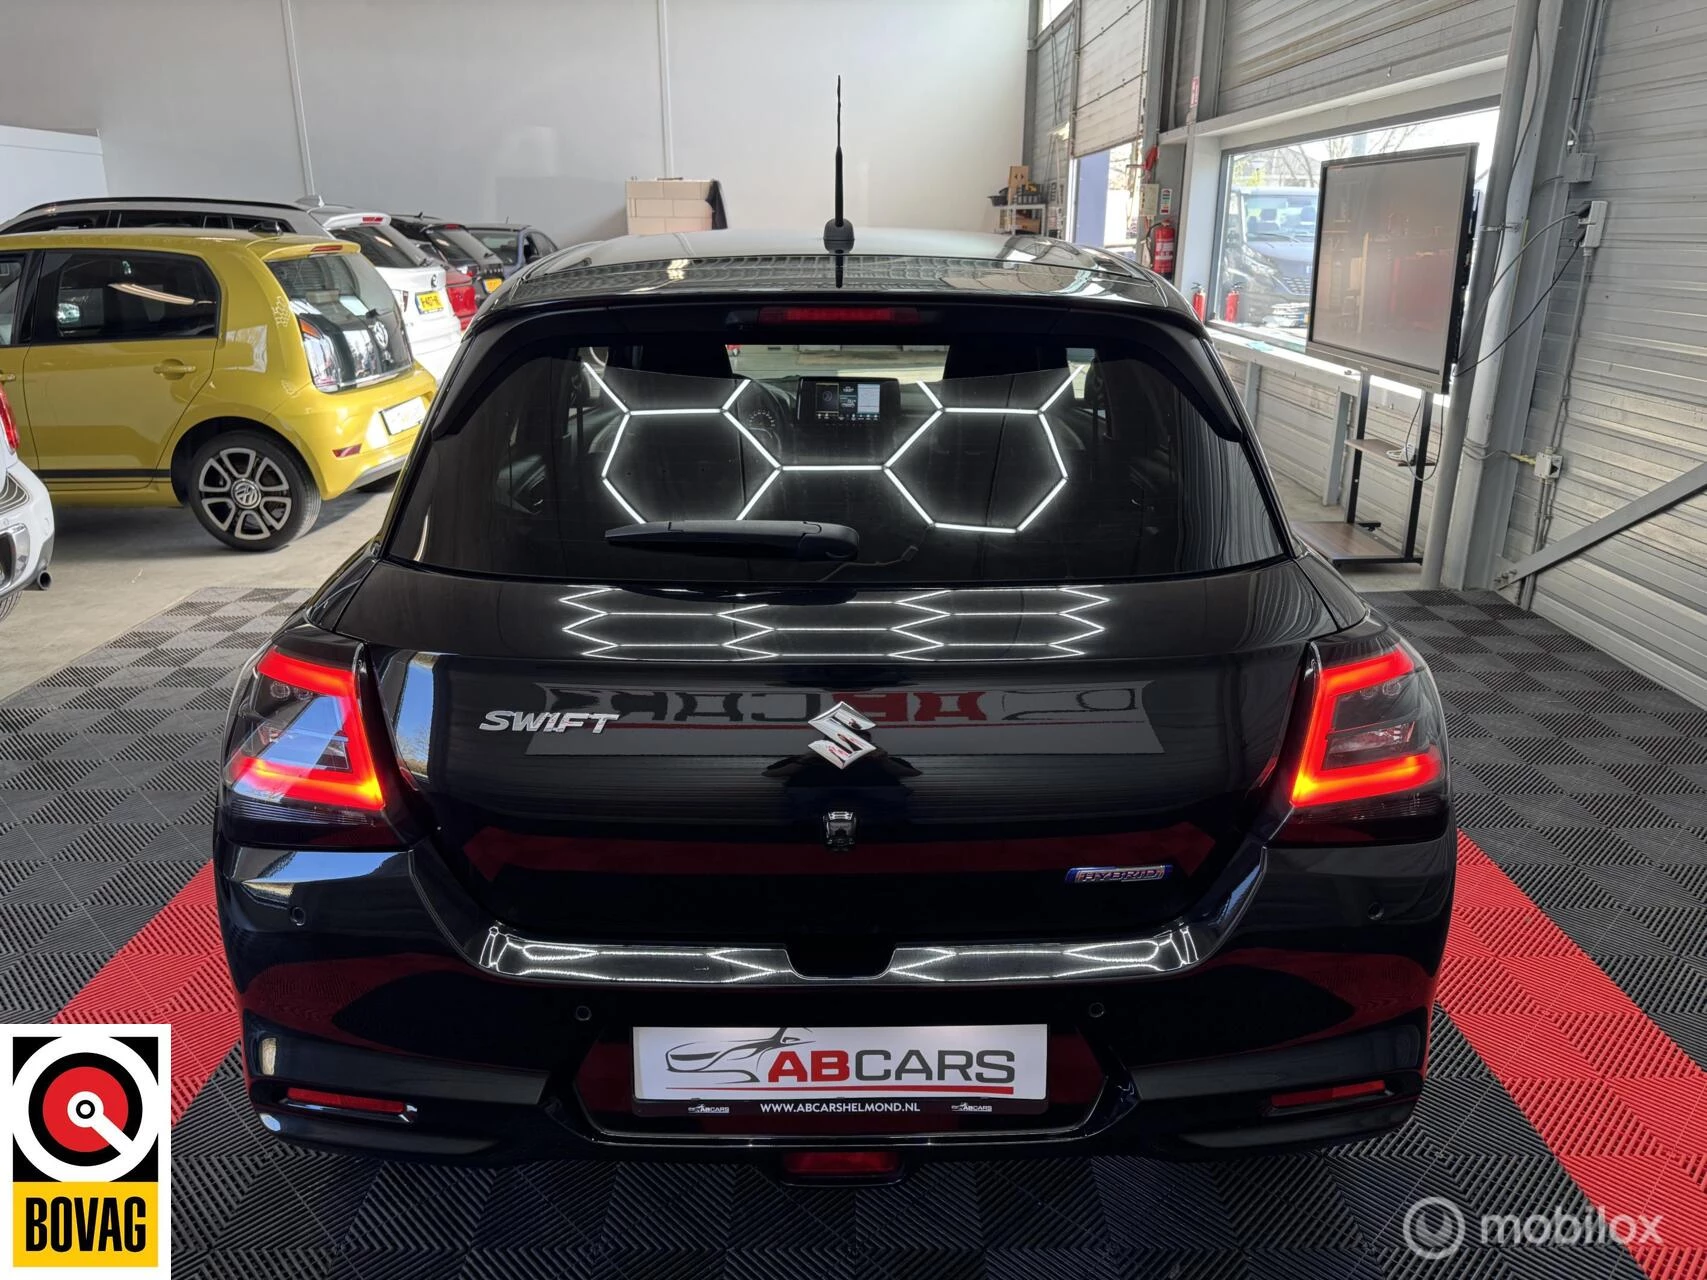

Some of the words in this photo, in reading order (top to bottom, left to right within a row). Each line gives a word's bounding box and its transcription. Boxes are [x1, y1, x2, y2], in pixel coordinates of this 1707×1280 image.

[479, 710, 620, 734] SWIFT
[1082, 869, 1159, 882] HYBRID
[767, 1049, 1015, 1084] ABCARS
[760, 1102, 921, 1113] WWW.ABCARSHELMOND.NL
